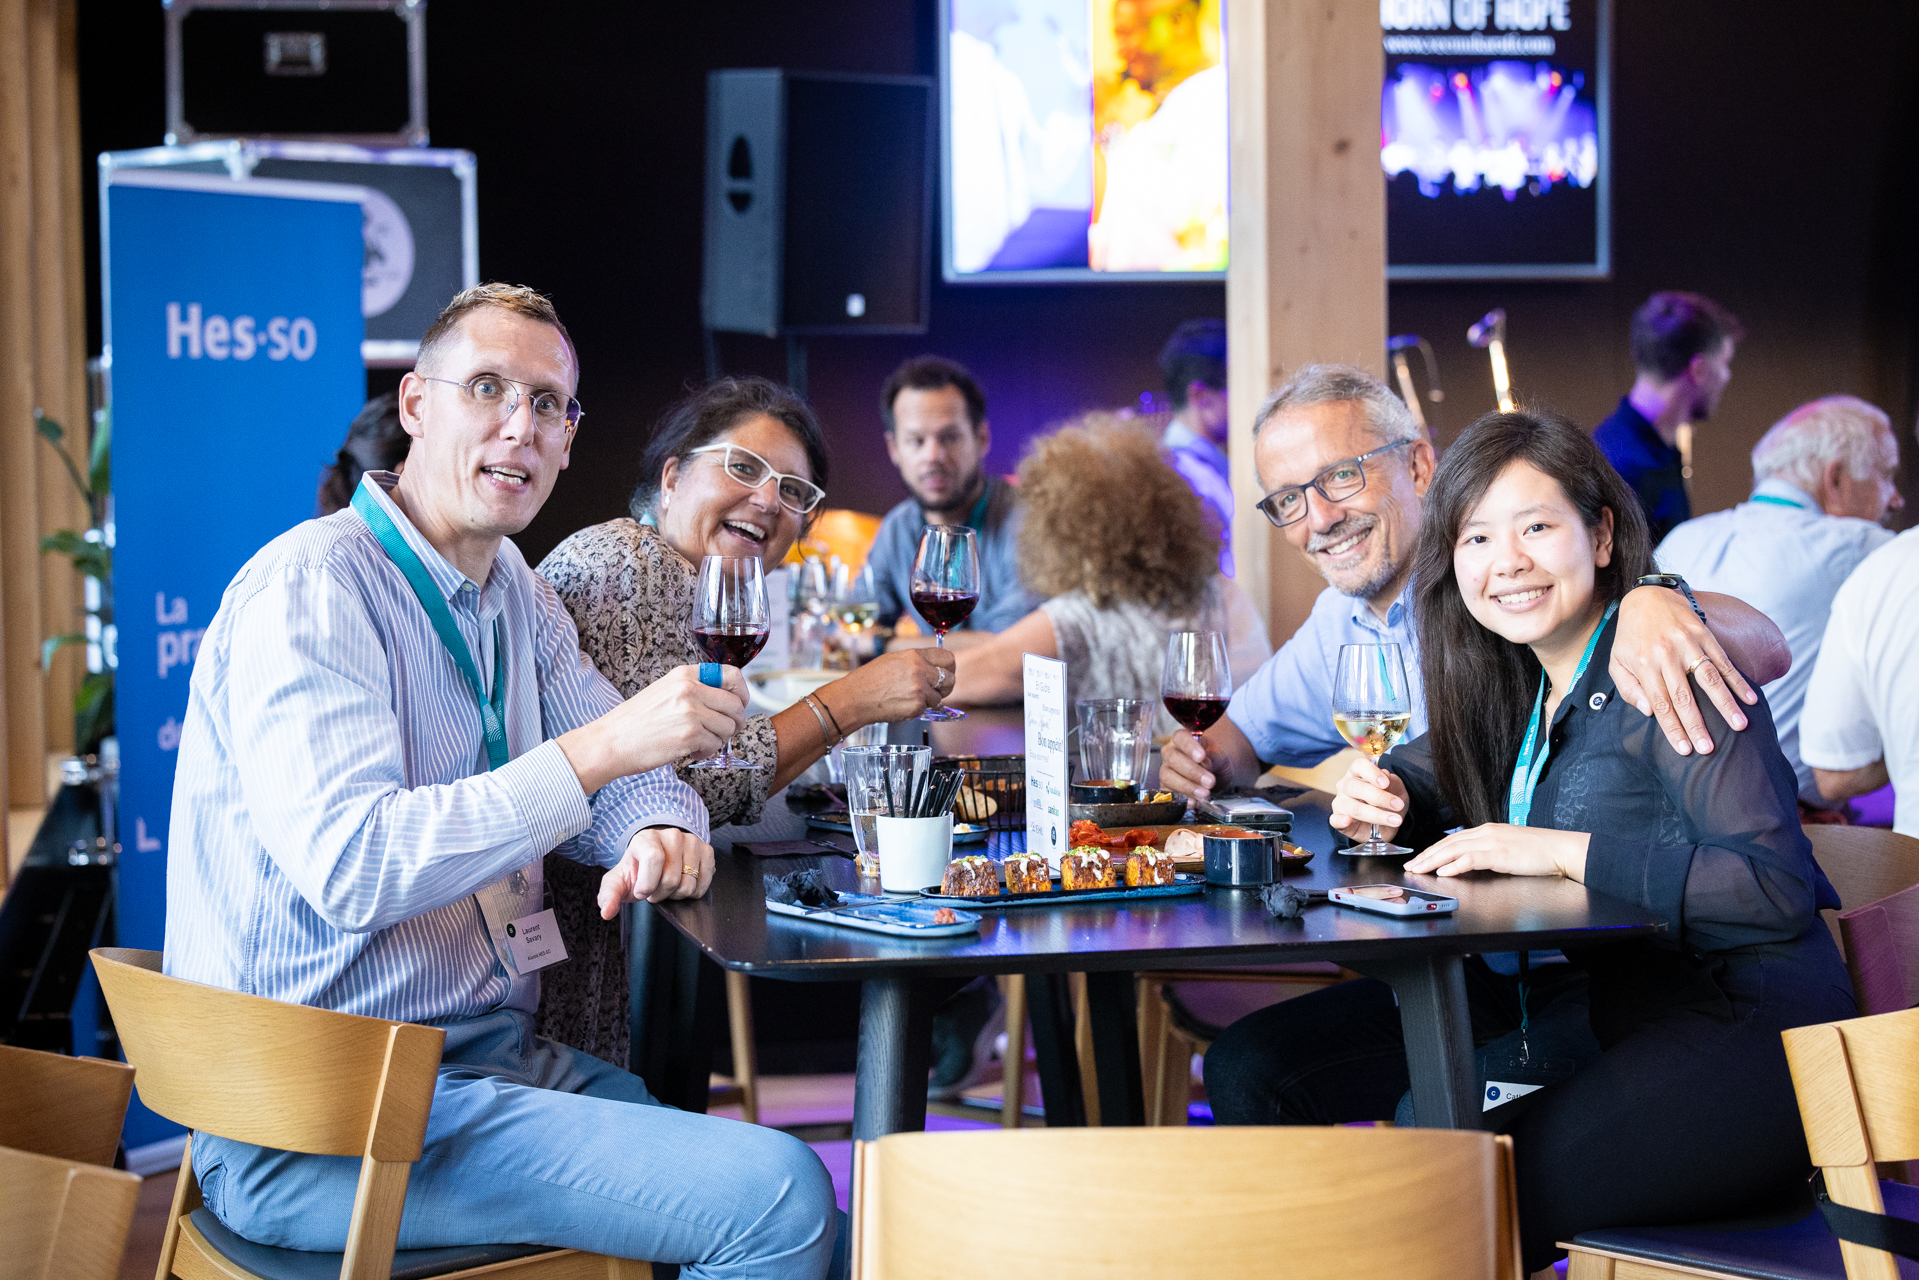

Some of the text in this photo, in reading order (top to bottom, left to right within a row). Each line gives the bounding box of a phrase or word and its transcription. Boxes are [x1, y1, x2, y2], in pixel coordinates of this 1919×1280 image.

[156, 591, 188, 626] La
[1037, 731, 1047, 747] Bon
[522, 924, 540, 935] Laurent
[525, 935, 542, 943] Savary
